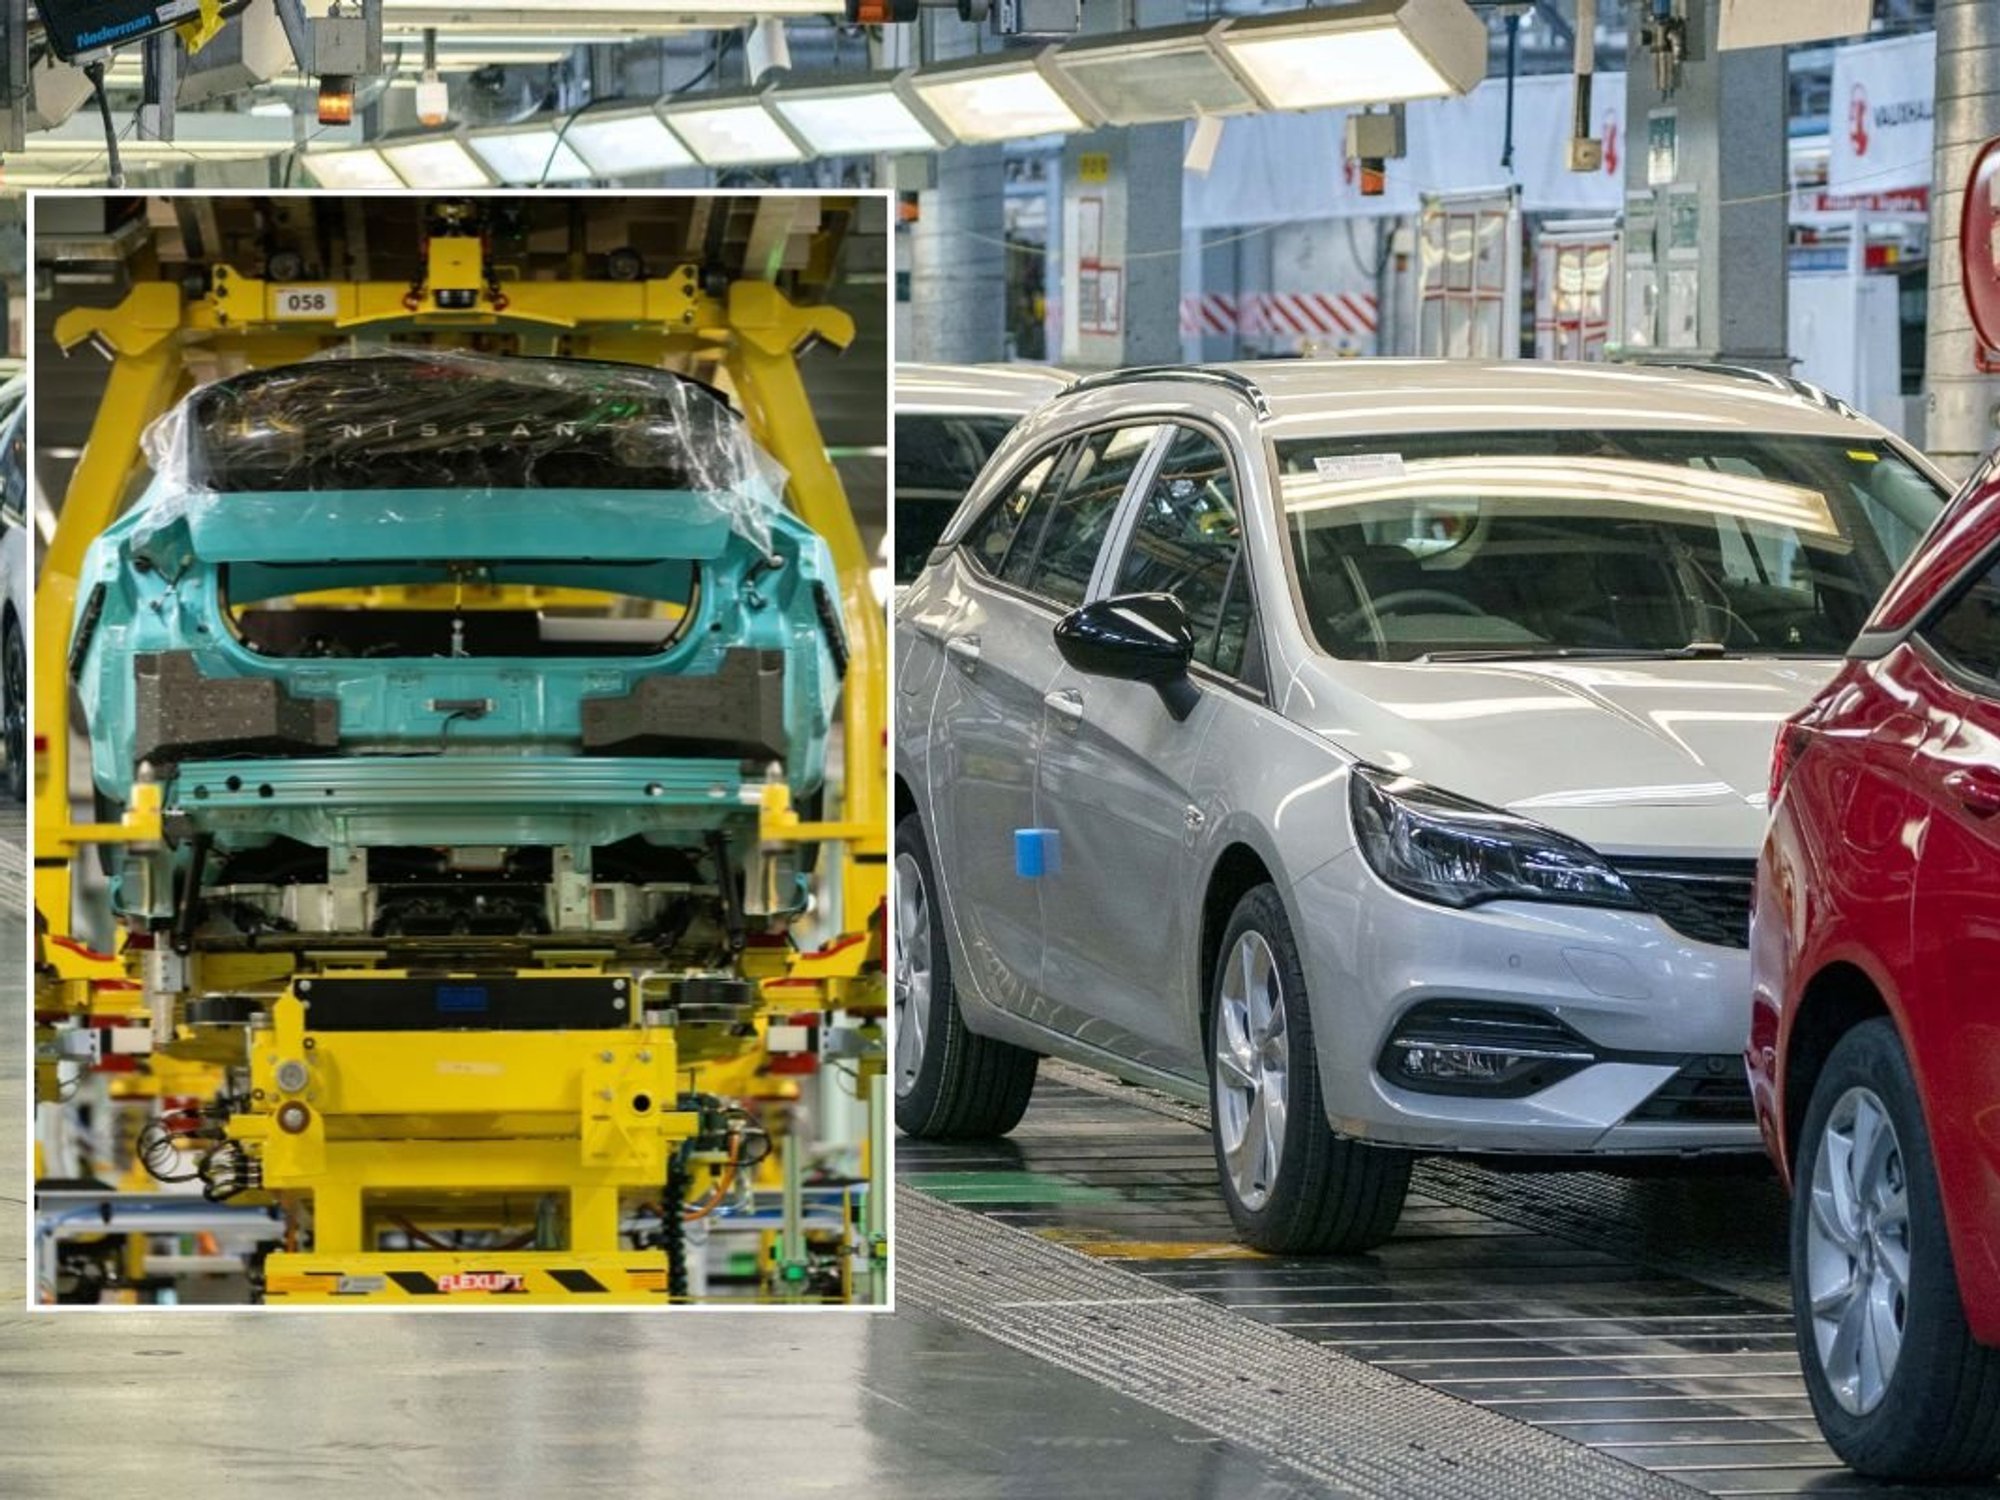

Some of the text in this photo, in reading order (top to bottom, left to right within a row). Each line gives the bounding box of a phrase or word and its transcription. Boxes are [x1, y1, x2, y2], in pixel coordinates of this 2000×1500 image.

[76, 15, 152, 47] Nederman
[289, 294, 326, 311] 058
[343, 422, 575, 438] NISSAN
[438, 1273, 524, 1291] FLEXLIFT
